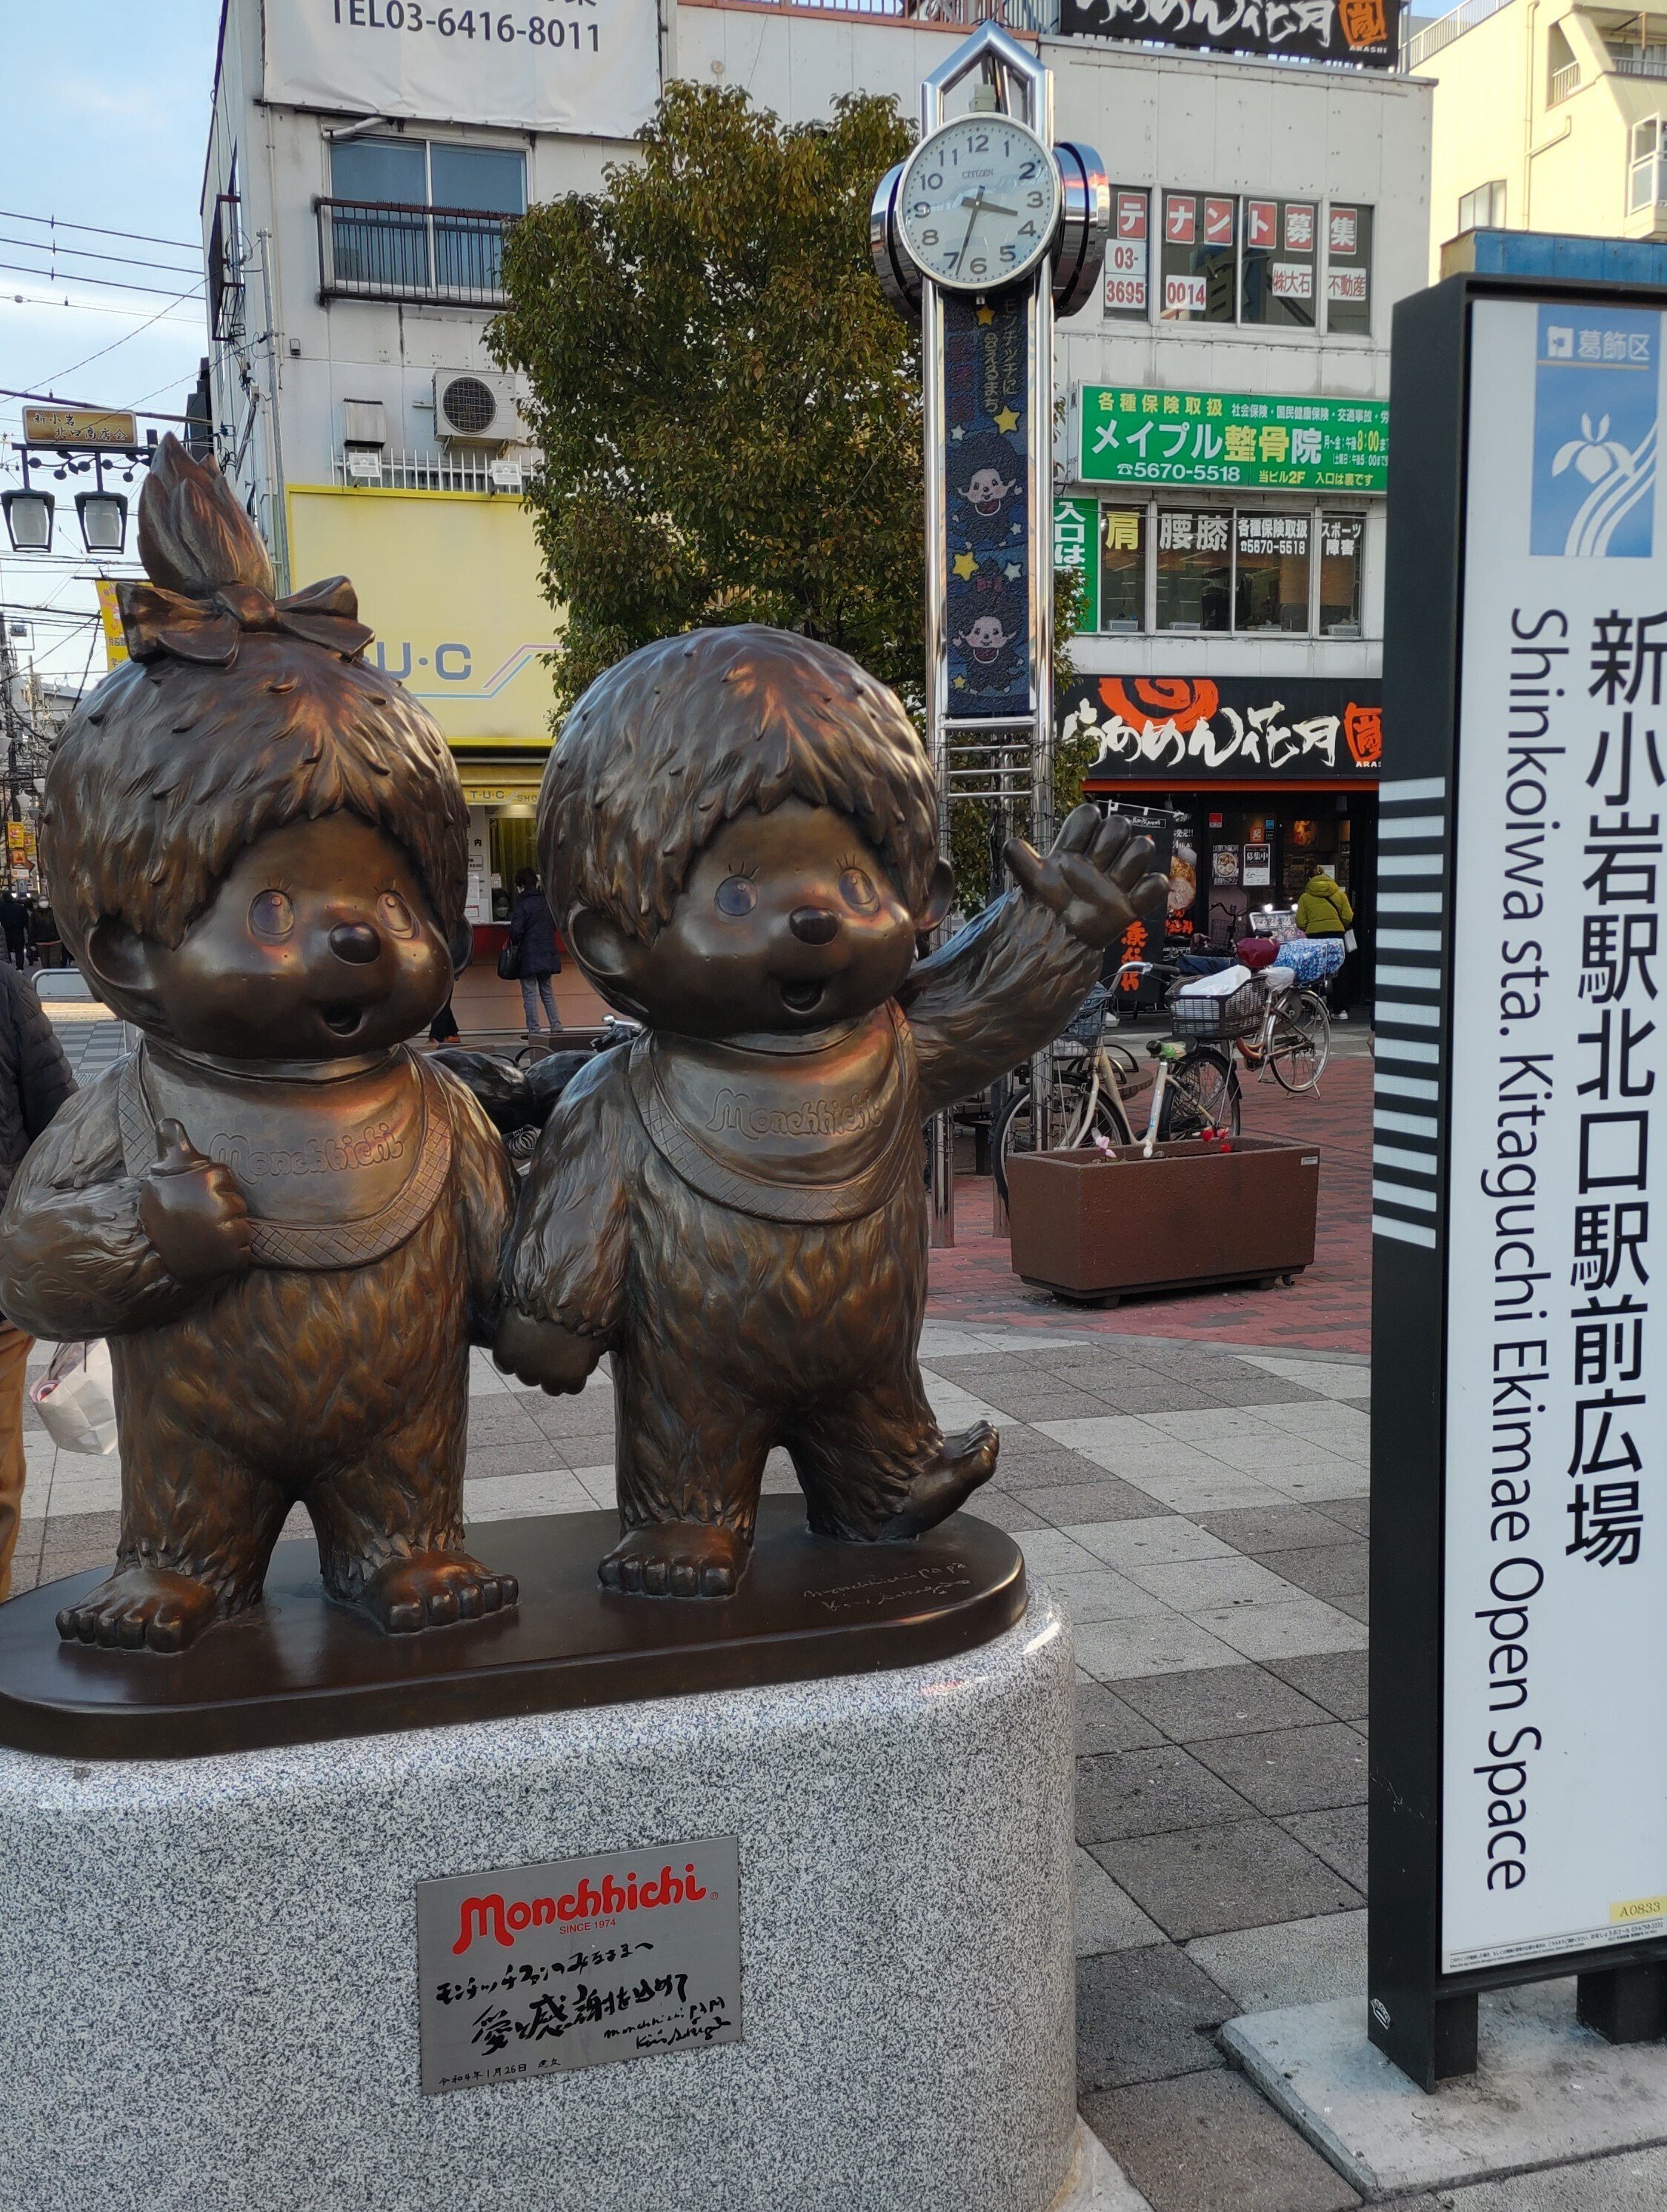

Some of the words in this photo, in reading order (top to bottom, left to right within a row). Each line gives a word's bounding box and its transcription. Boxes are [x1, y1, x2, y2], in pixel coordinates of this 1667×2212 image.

[1349, 45, 1388, 54] ARASHI
[967, 134, 989, 153] 12
[1004, 140, 1009, 157] 1
[938, 149, 958, 166] 11
[962, 168, 994, 179] CITIZEN
[1019, 161, 1036, 180] 2
[919, 173, 943, 190] 10
[1027, 191, 1043, 208] 3
[914, 201, 931, 219] 9
[1017, 221, 1036, 236] 4
[922, 229, 939, 246] 8
[943, 252, 959, 269] 7
[999, 245, 1016, 262] 5
[1114, 247, 1139, 270] 03-
[970, 257, 987, 274] 6
[1106, 280, 1145, 304] 3695
[1167, 282, 1205, 305] 0014
[1578, 329, 1651, 361] 葛飾区
[1098, 392, 1223, 418] 各種保険取扱
[33, 412, 76, 427] 新小岩
[55, 427, 128, 442] 北口商店会
[1091, 419, 1322, 465] メイプル整骨院
[1258, 470, 1307, 484] 当ビル2F
[1315, 471, 1374, 487] 入口は裏です
[1105, 511, 1141, 550] 肩
[1238, 517, 1308, 539] 各種保険取扱
[1321, 522, 1361, 539] スポーツ
[1325, 539, 1355, 556] 障害
[1502, 608, 1570, 920] Shinkoiwa
[1499, 940, 1550, 1036] sta.
[1563, 609, 1667, 1568] 新小岩駅北口駅前広場
[1480, 1054, 1554, 1322] Kitaguchi
[1489, 1339, 1549, 1542] Ekimae
[1474, 1556, 1545, 1712] Open
[1473, 1726, 1542, 1891] Space
[451, 1863, 707, 1955] Monchhichi
[1620, 1901, 1662, 1918] A0833
[559, 1923, 591, 1935] SINCE
[594, 1918, 616, 1929] 1974
